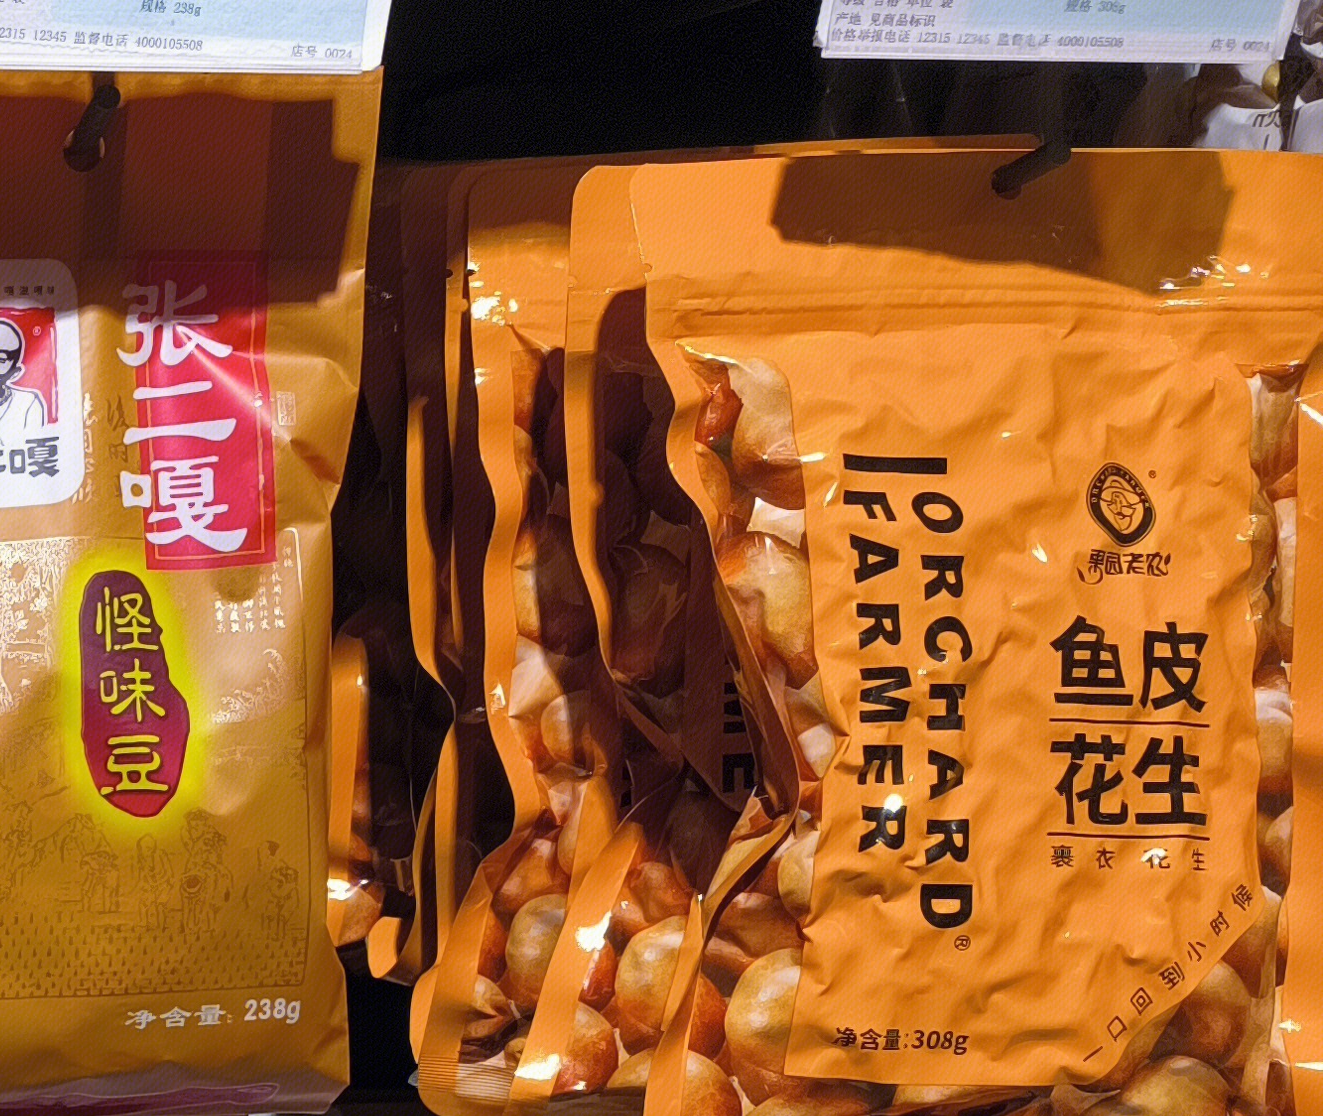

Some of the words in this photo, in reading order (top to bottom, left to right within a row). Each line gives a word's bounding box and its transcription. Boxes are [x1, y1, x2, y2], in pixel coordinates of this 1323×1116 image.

[34, 30, 67, 42] 12345
[74, 32, 128, 47] 监督电话
[135, 37, 203, 51] 4000105508
[173, 2, 201, 16] 238g
[917, 32, 951, 44] 12315
[292, 44, 317, 58] 店号
[325, 47, 353, 59] 0024
[116, 280, 248, 553] 张二嘎
[95, 586, 169, 795] 怪味豆
[842, 489, 912, 853] FARMER
[1049, 615, 1209, 714] 鱼皮
[910, 490, 973, 930] ORCHARD
[1049, 733, 1207, 826] 花生
[1049, 845, 1207, 872] 裹衣花生
[1082, 881, 1255, 1063] 一口回到小时候
[124, 1003, 233, 1030] 净含量:
[243, 997, 301, 1025] 238g
[833, 1026, 969, 1055] 净含量:308g
